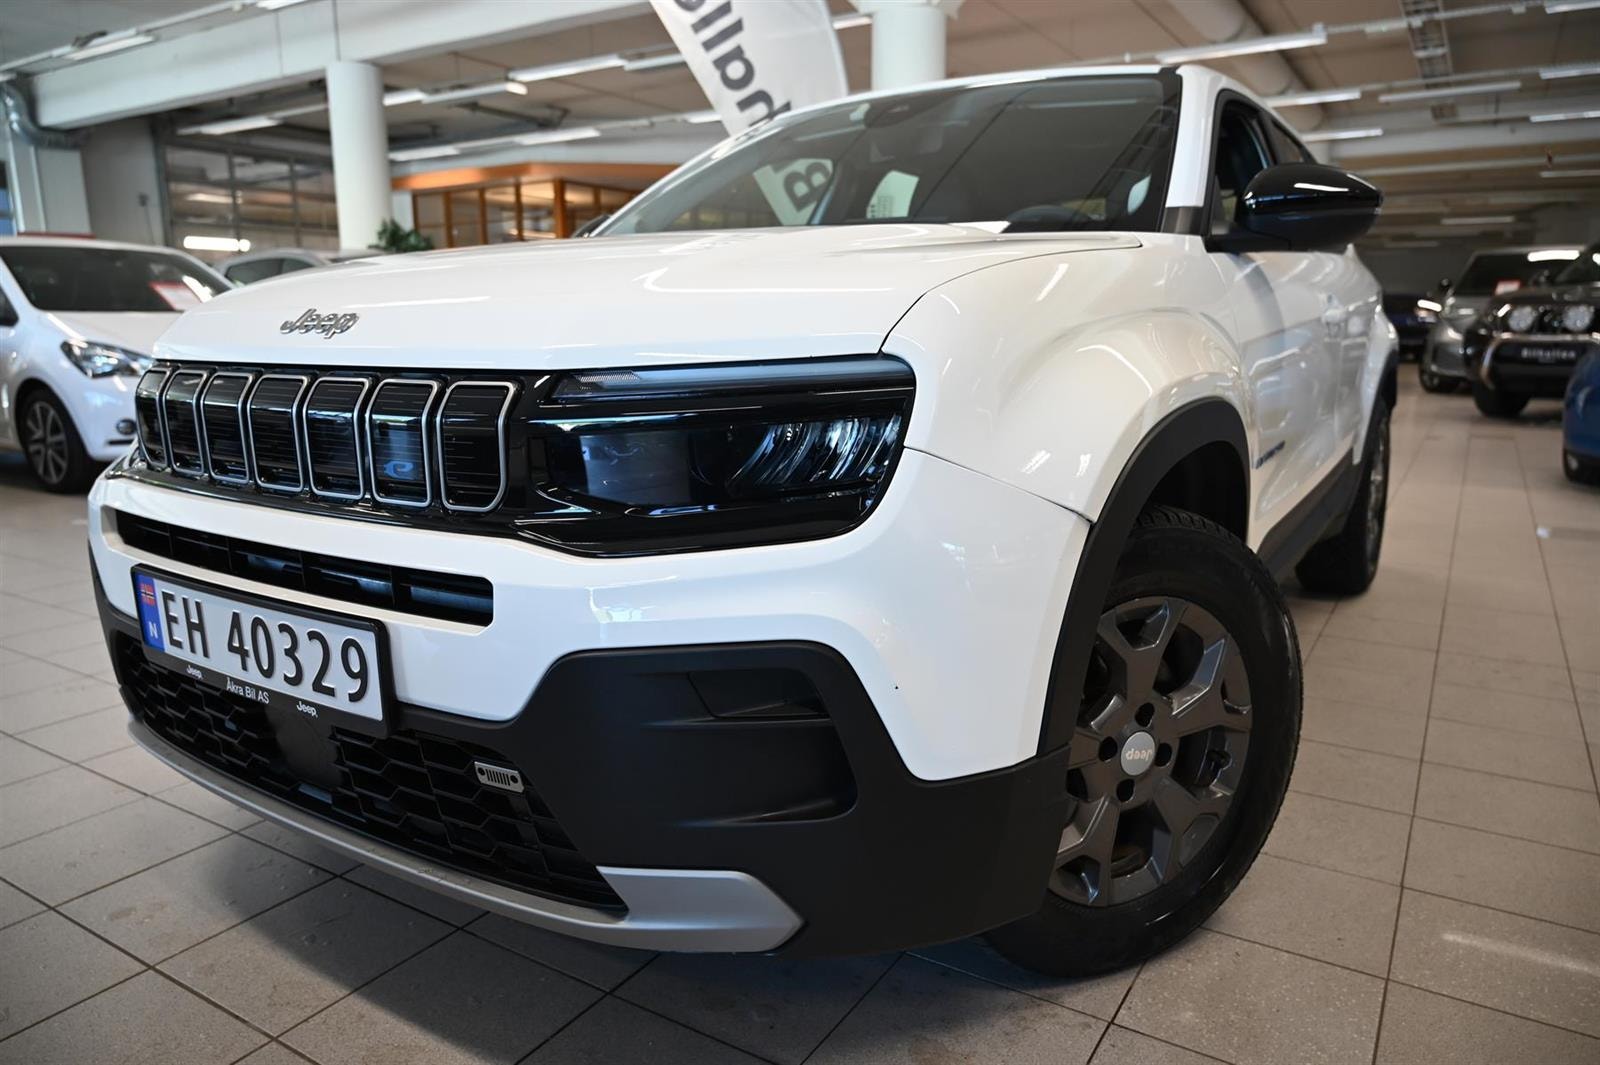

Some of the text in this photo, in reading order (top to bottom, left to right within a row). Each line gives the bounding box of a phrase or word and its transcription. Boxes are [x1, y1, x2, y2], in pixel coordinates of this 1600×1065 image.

[280, 308, 359, 340] Jeep
[149, 621, 160, 639] N
[161, 590, 369, 704] EH 40329
[186, 665, 203, 680] Jeep
[226, 677, 270, 704] Åkra Bil AS
[296, 701, 317, 718] Jeep
[1125, 748, 1153, 762] Jeep
